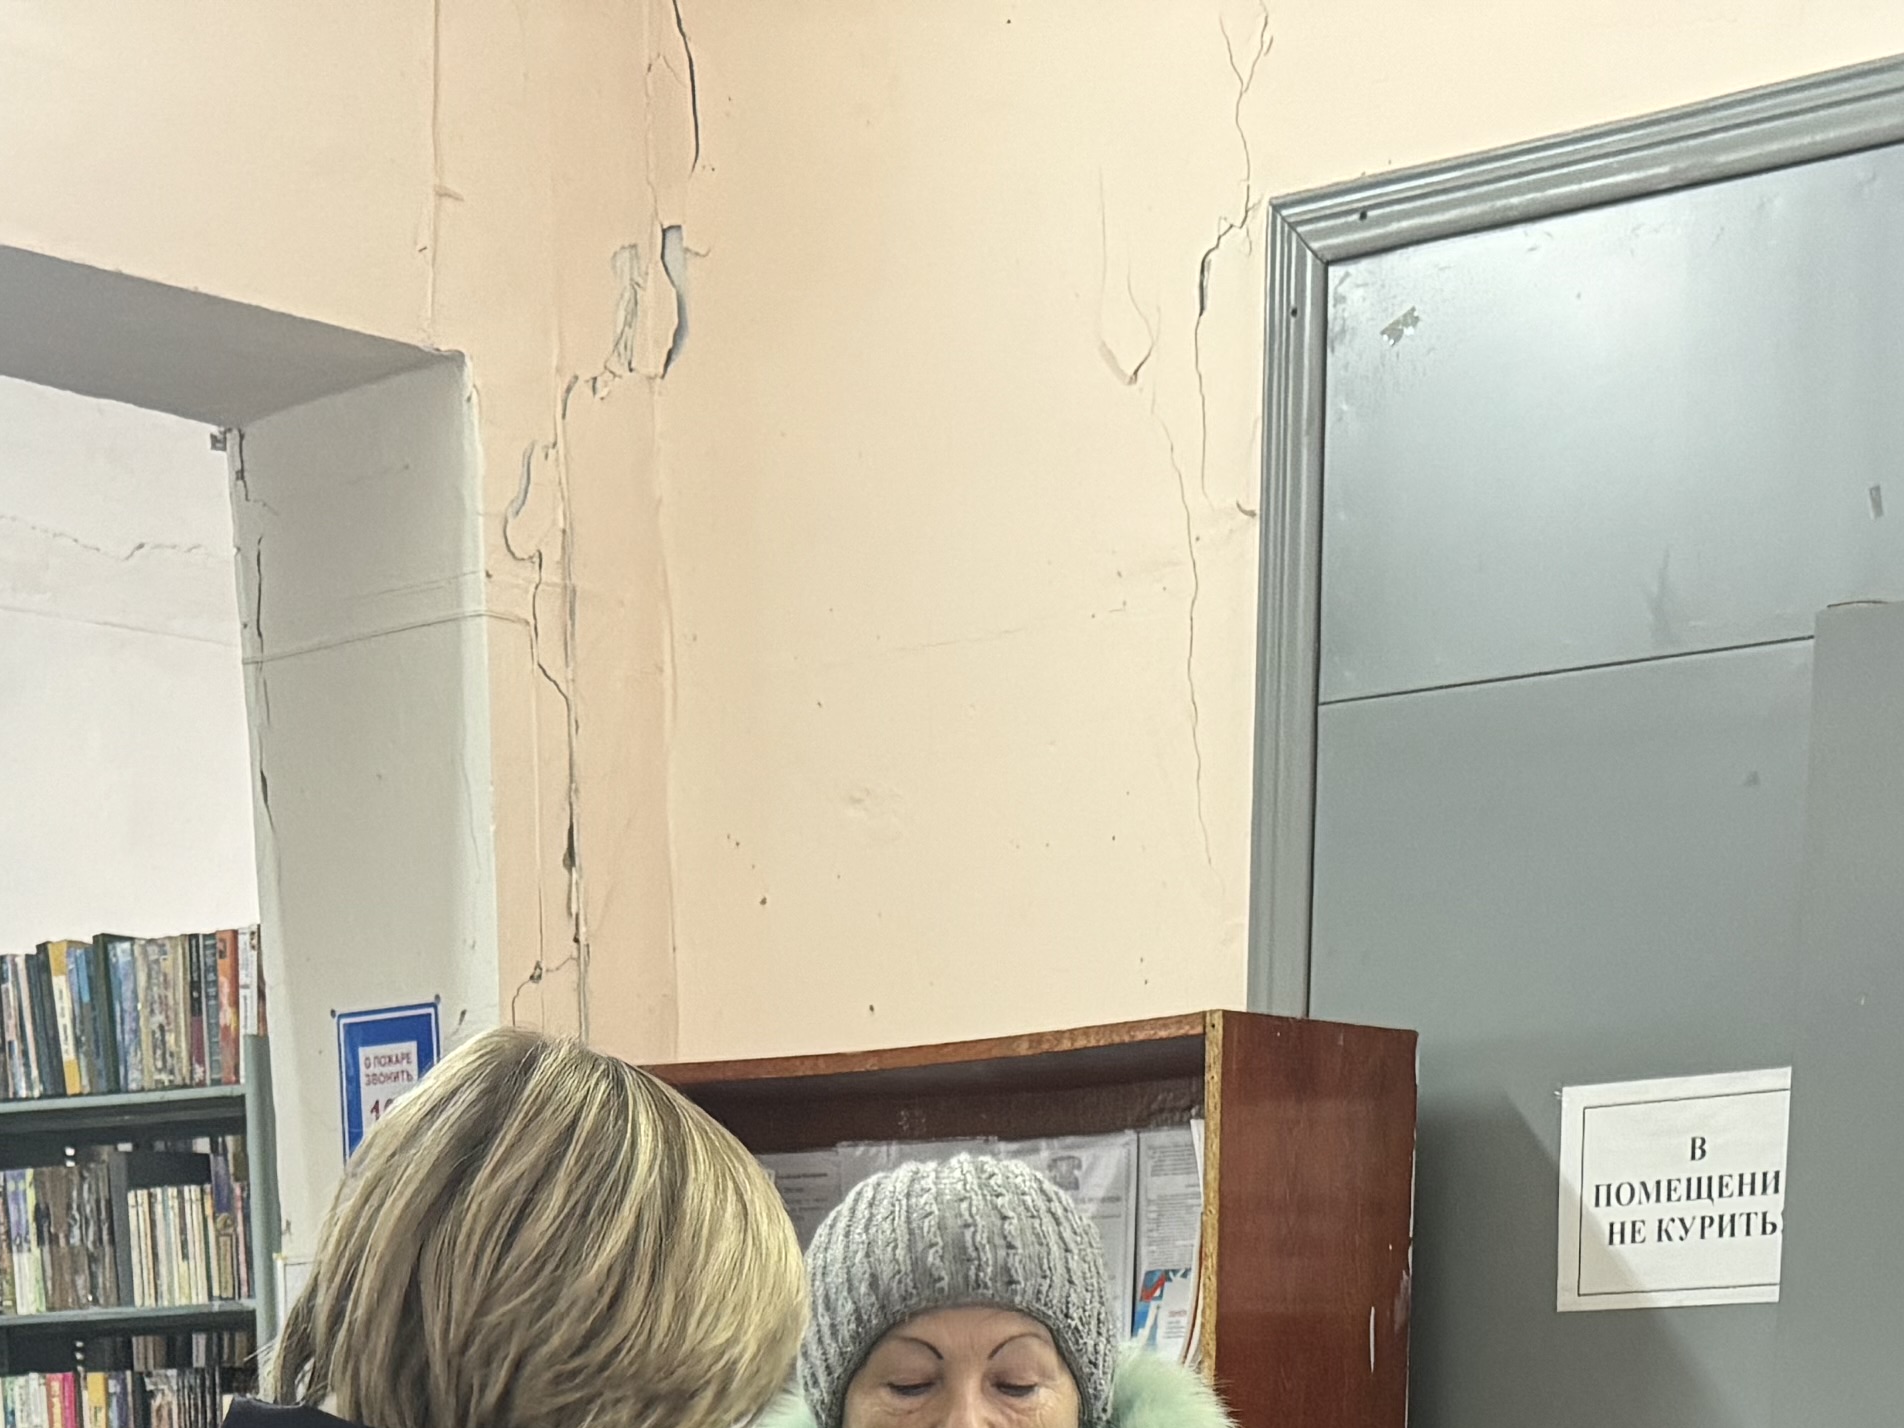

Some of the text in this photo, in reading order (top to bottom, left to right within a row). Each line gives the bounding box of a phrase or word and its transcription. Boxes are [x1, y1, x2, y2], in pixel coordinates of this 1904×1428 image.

[373, 1052, 412, 1068] ПОЖАРЕ
[364, 1070, 414, 1086] ЗВОНИТЬ
[1689, 1136, 1707, 1162] В
[1593, 1170, 1781, 1209] ПОМЕЩЕНИ
[1607, 1211, 1778, 1247] НЕ КУРИТЬ
